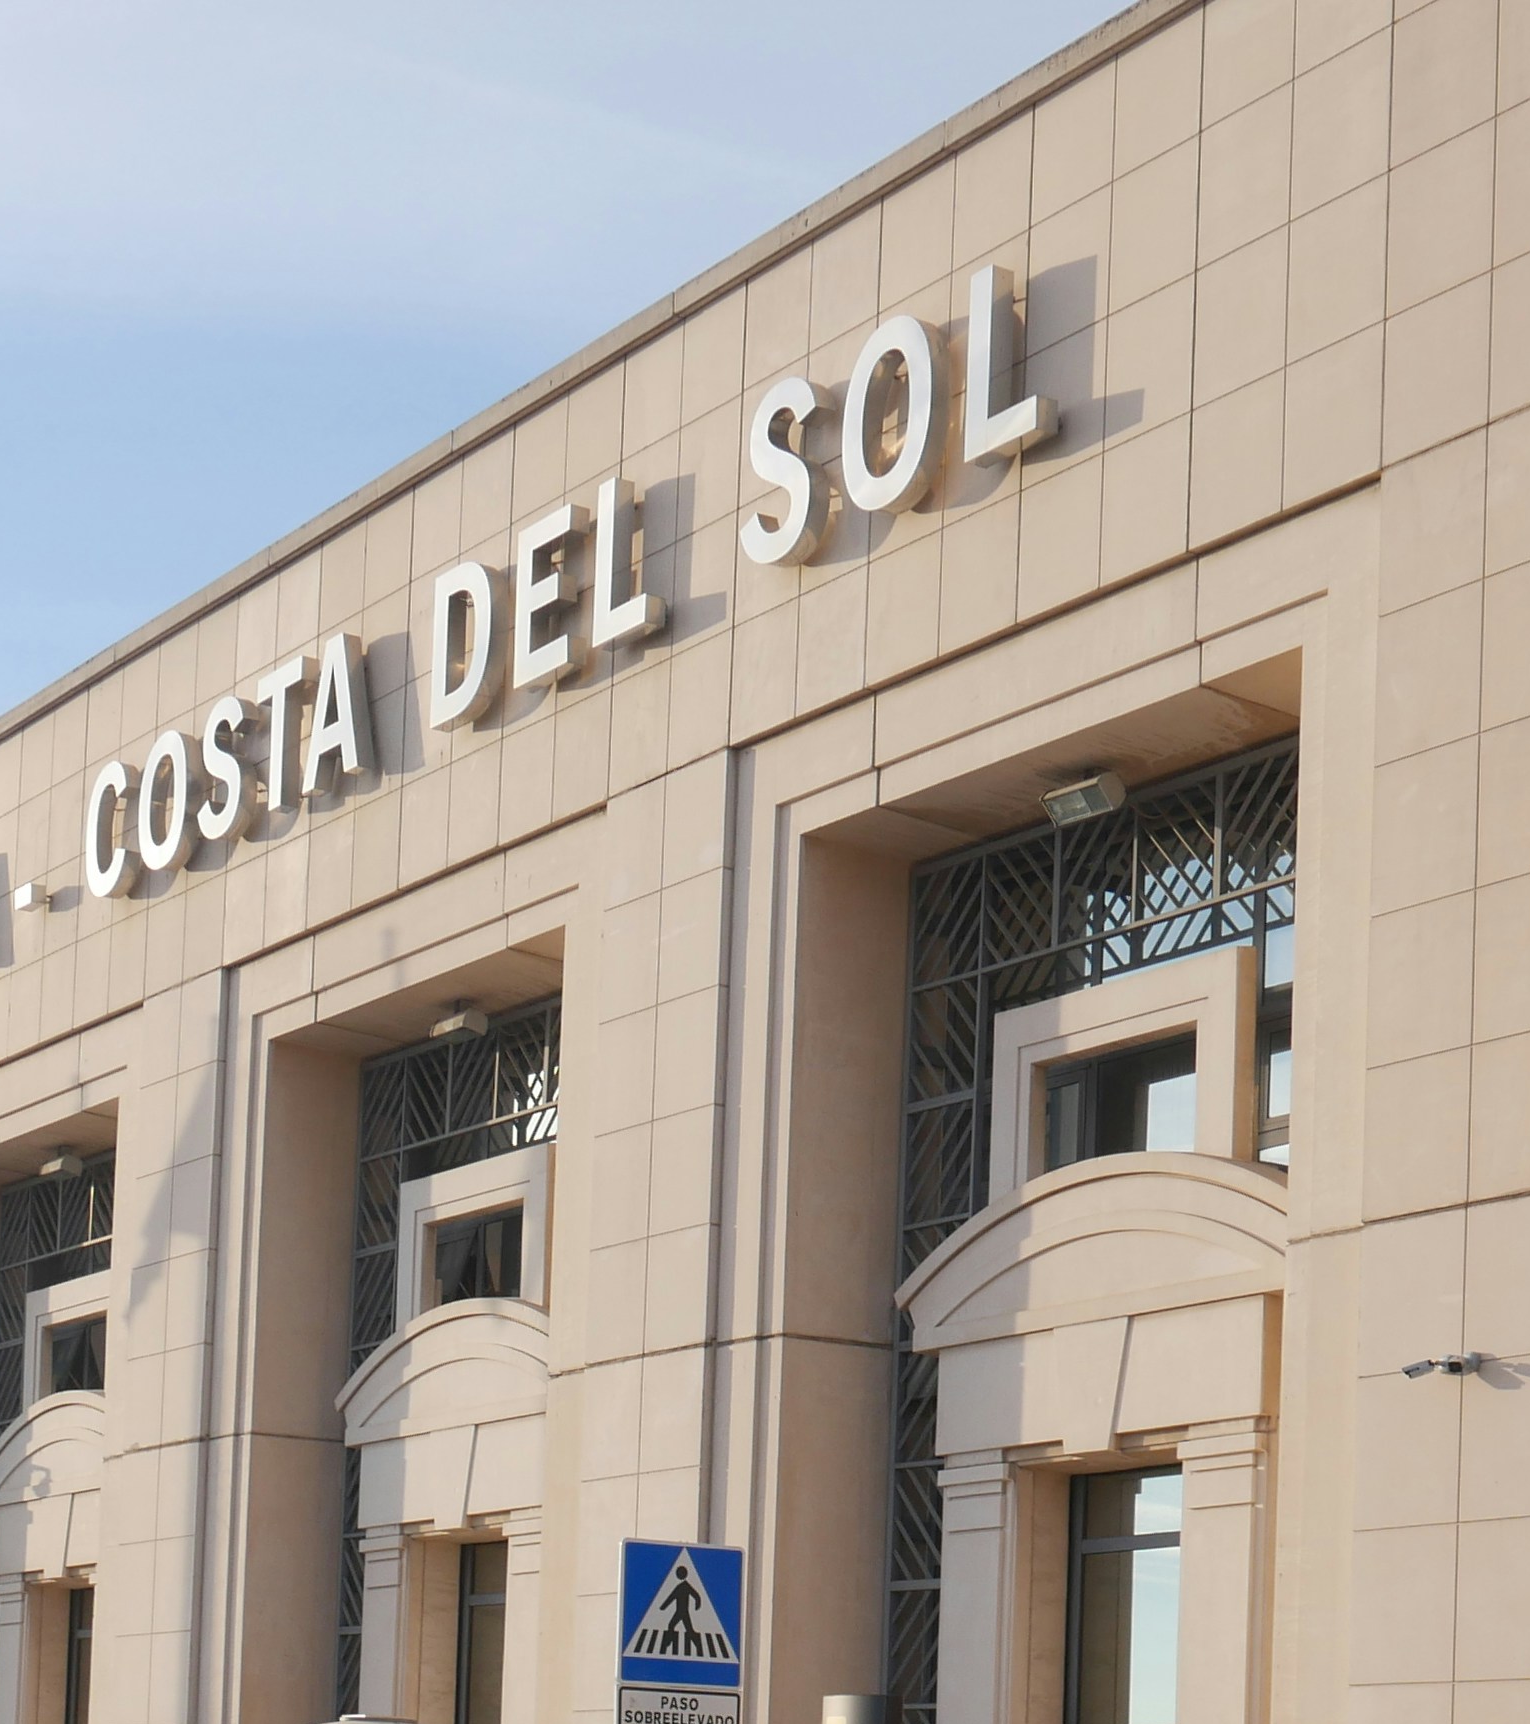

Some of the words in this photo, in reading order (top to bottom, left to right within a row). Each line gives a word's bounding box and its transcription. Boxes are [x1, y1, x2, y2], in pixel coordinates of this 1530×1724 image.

[85, 632, 363, 898] COSTA
[430, 476, 651, 730] DEL
[739, 263, 1042, 565] SOL
[660, 1696, 699, 1711] PASO
